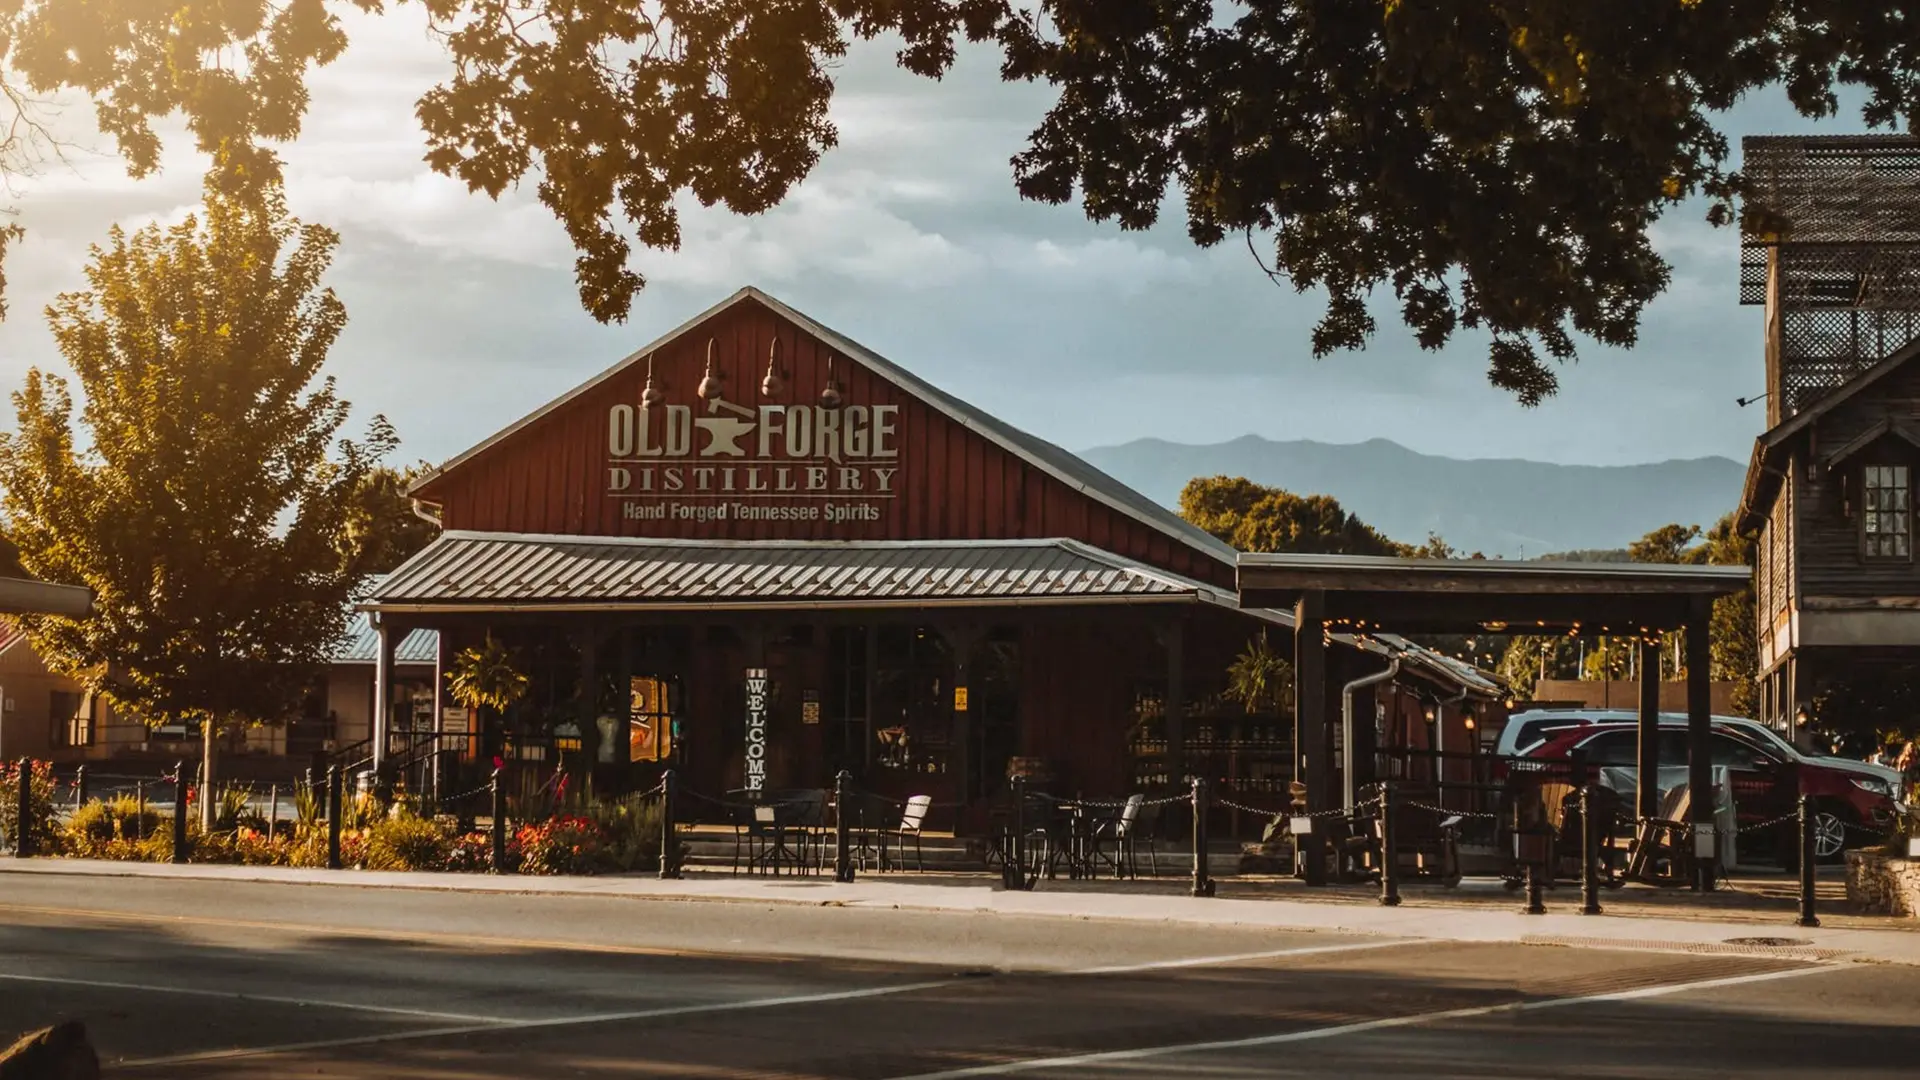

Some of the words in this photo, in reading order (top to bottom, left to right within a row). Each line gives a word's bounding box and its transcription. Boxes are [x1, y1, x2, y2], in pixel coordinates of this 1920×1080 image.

[609, 404, 691, 457] OLD
[757, 404, 898, 464] FORGE
[607, 467, 898, 491] DISTILLERY
[624, 502, 665, 519] Hand
[671, 502, 727, 522] Forged
[731, 502, 819, 520] Tennessee
[823, 503, 880, 523] Spirits
[747, 679, 767, 790] WELCOME
